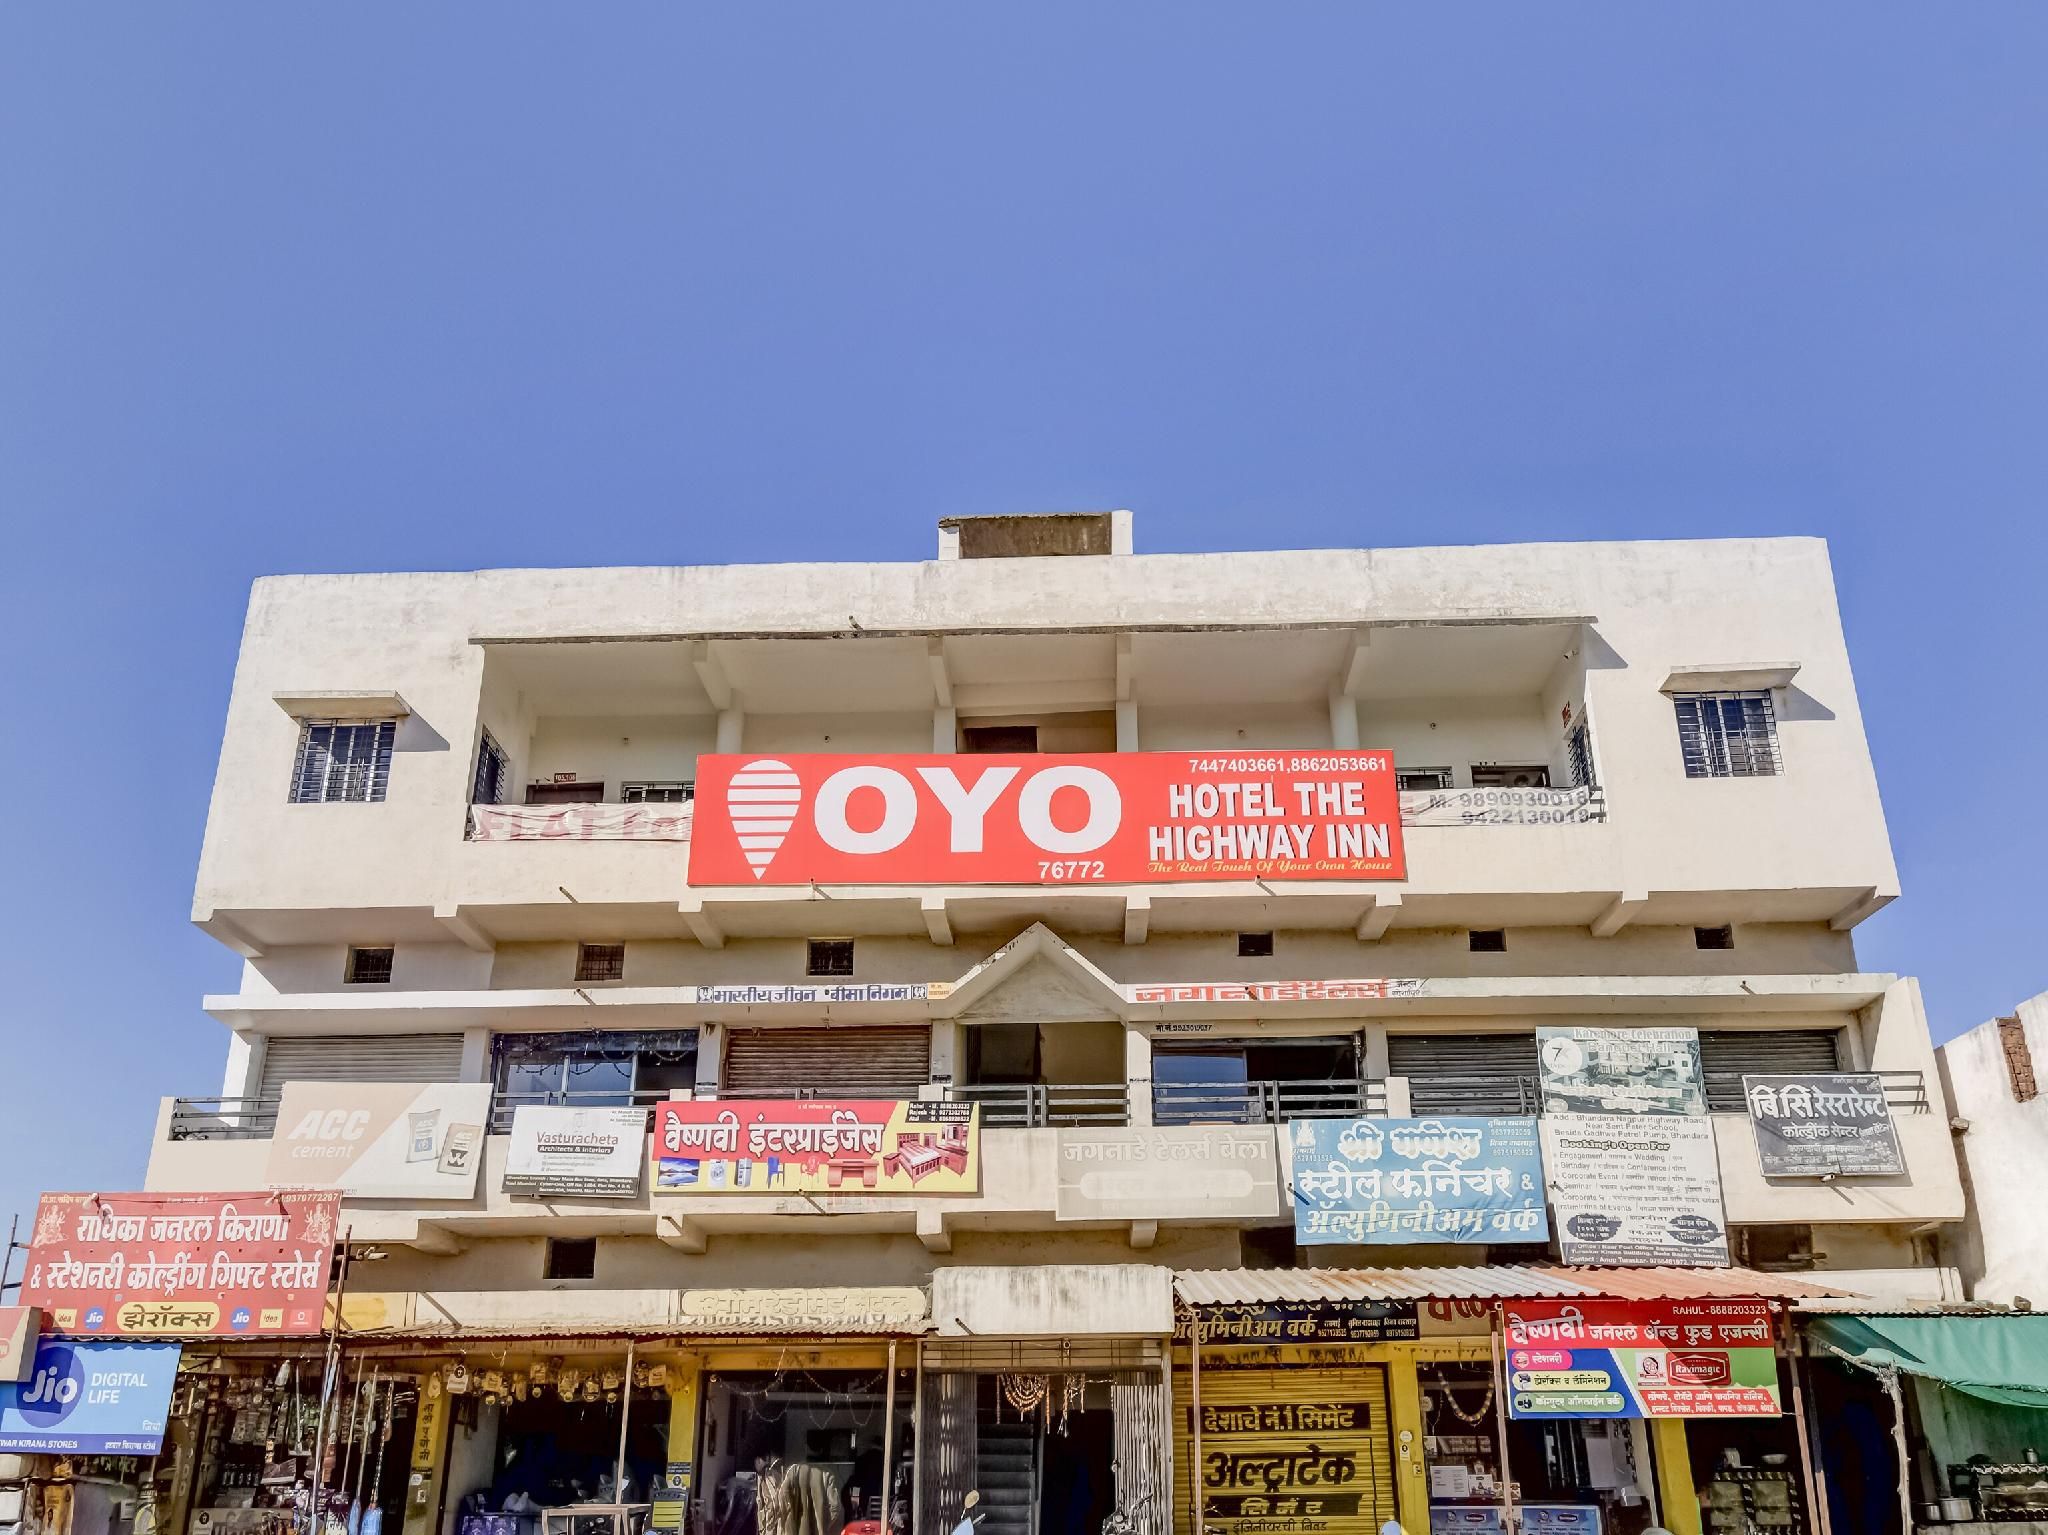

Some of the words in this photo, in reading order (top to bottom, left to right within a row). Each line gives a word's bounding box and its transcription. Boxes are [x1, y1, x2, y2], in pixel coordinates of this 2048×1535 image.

[1189, 757, 1387, 774] 7447403661,8862053661
[814, 764, 1123, 855] OYO
[1169, 782, 1286, 818] HOTEL
[1293, 782, 1367, 816] THE
[1149, 824, 1316, 861] HIGHWAY
[1326, 823, 1392, 859] INN
[1037, 861, 1105, 880] 76772
[1148, 860, 1174, 873] The
[1175, 860, 1208, 873] Real
[1211, 860, 1252, 873] Touch
[1255, 859, 1273, 873] Of
[1276, 859, 1313, 874] Your
[1314, 859, 1346, 871] Own
[1349, 858, 1394, 871] House
[713, 985, 773, 1003] भारतीय
[774, 985, 817, 1002] जीवन
[830, 986, 866, 1001] बीमा
[867, 984, 909, 1001] निगम
[287, 1107, 372, 1140] ACC
[663, 1111, 742, 1153] वैष्णवी
[292, 1143, 355, 1159] cement
[536, 1131, 619, 1146] Vasturacheta
[1559, 1138, 1618, 1151] Booking's
[1618, 1140, 1650, 1151] Open
[1649, 1140, 1671, 1151] For
[1297, 1160, 1384, 1200] स्टील
[1390, 1159, 1513, 1199] फर्निचर
[1520, 1173, 1536, 1191] &
[1491, 1197, 1544, 1233] वर्क
[149, 1214, 216, 1243] जनरल
[30, 1263, 42, 1289] &
[46, 1250, 126, 1290] स्टेशनरी
[208, 1250, 270, 1290] गिफ्ट
[271, 1248, 323, 1289] स्टोर्स
[86, 1311, 104, 1324] Jio
[122, 1304, 215, 1331] झेरॉक्स
[232, 1311, 250, 1324] Jio
[1672, 1306, 1705, 1315] RAHUL
[1286, 1313, 1320, 1338] वर्क
[1507, 1305, 1585, 1345] वैष्णवी
[1588, 1324, 1638, 1341] जनरल
[1683, 1324, 1713, 1346] फुड
[1718, 1317, 1769, 1344] एजन्सी
[90, 1372, 149, 1388] DIGITAL
[1675, 1363, 1721, 1376] Ravimagic
[22, 1366, 78, 1404] Jio
[88, 1389, 121, 1404] LIFE
[1297, 1404, 1356, 1430] सिमेंट
[18, 1439, 47, 1449] KIRANA
[47, 1440, 79, 1449] STORES
[1204, 1443, 1357, 1494] अल्ट्राटेक
